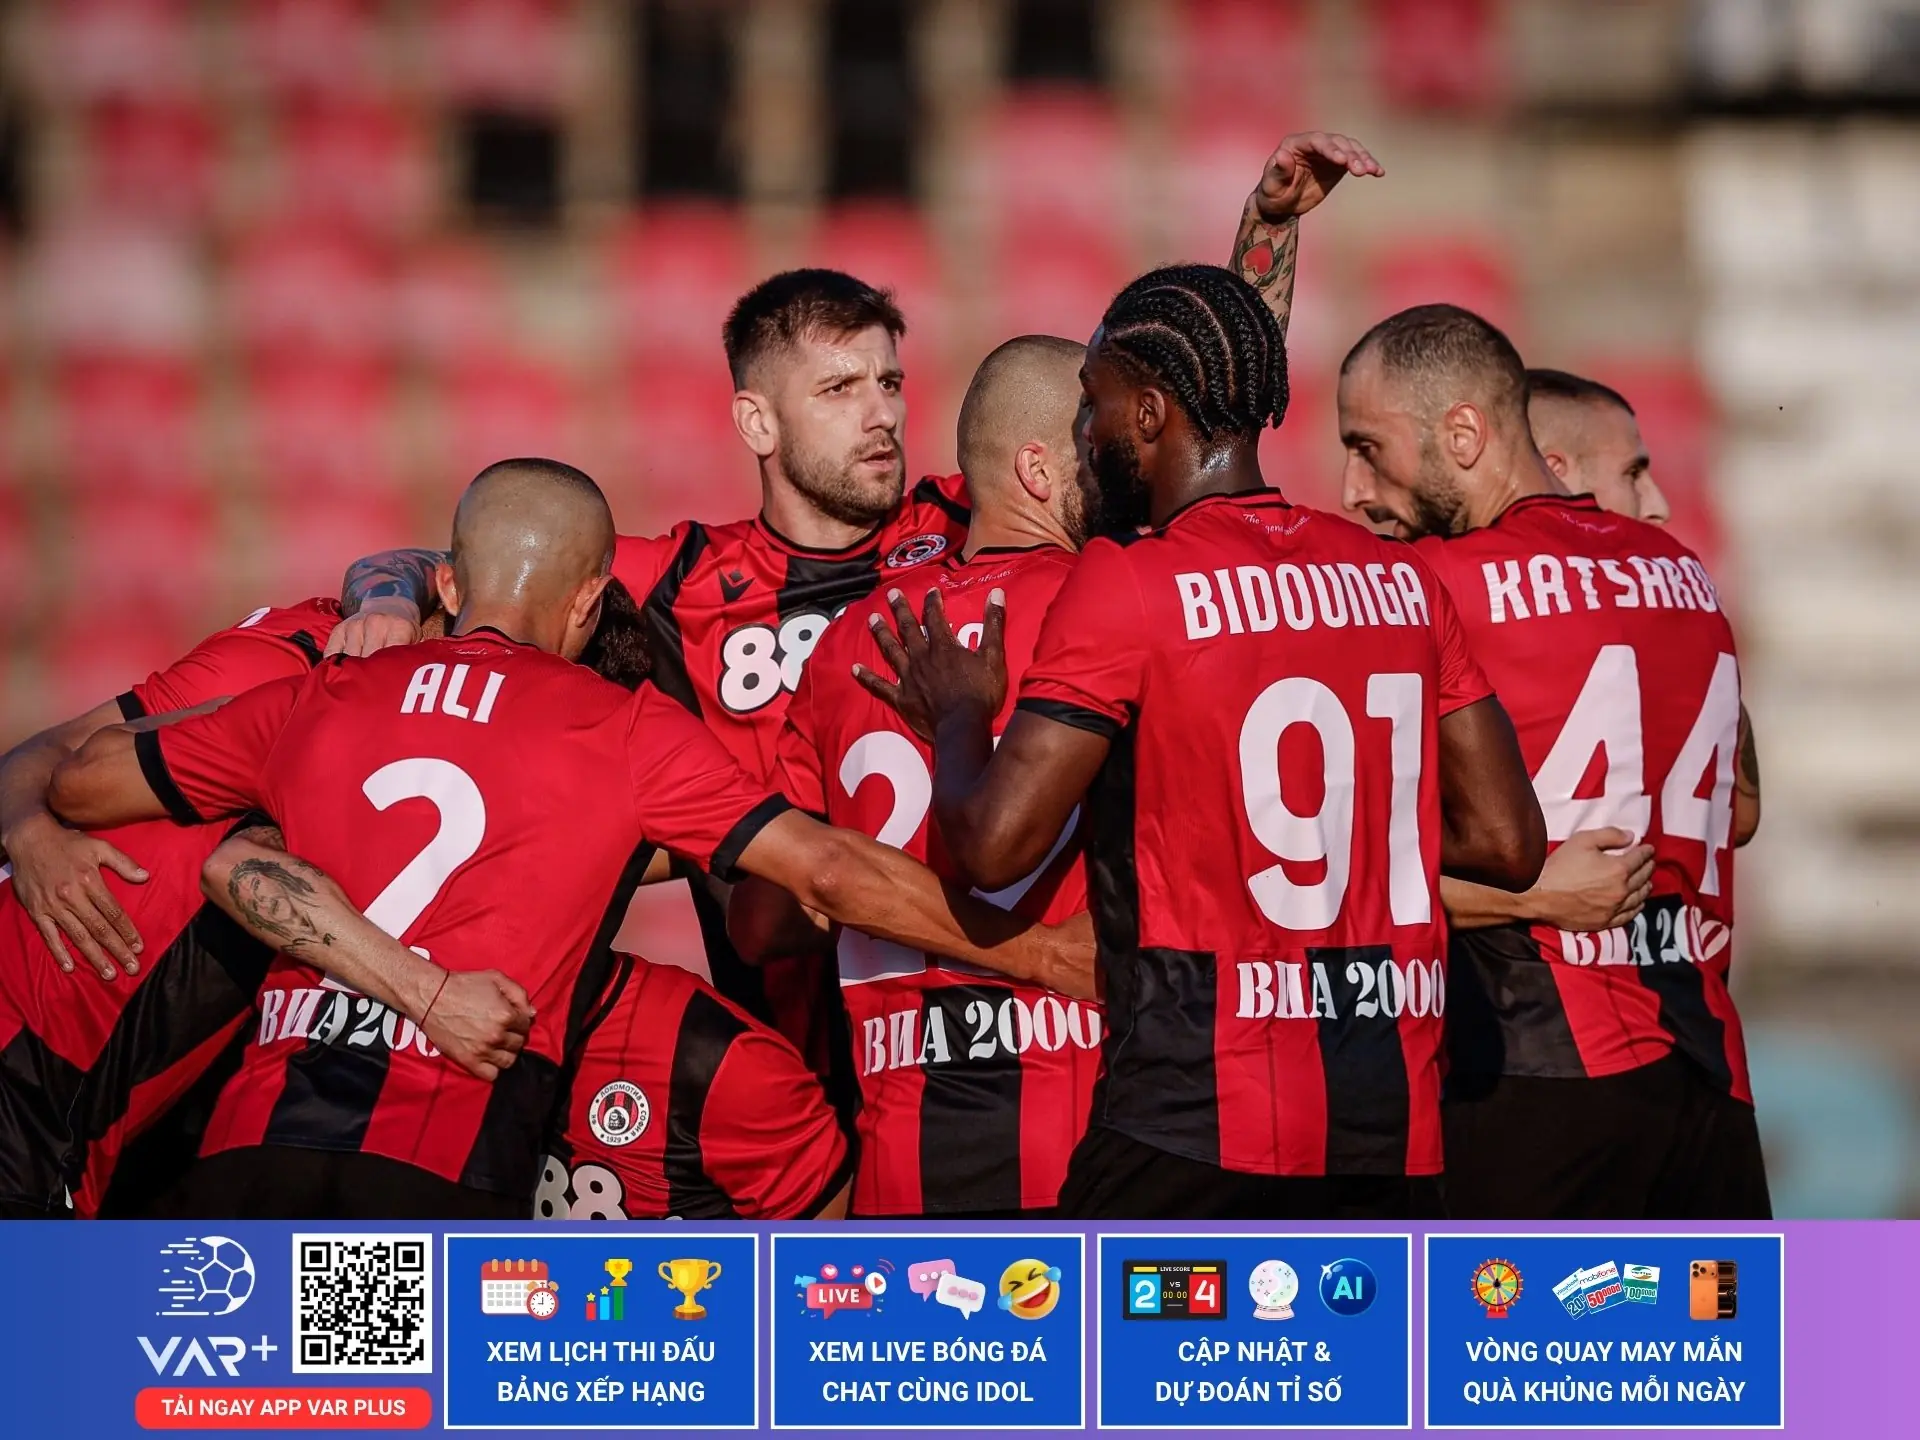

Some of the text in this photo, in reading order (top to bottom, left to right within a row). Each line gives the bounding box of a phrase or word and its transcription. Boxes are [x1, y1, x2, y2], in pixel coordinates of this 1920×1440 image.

[1174, 561, 1431, 641] BIDOUNGA
[399, 662, 507, 724] ALI
[720, 605, 848, 711] 88
[1238, 672, 1433, 931] 91
[1532, 644, 1740, 897] 44
[318, 757, 487, 996] 2
[258, 988, 350, 1047] ВИА
[1345, 958, 1446, 1019] 2000
[863, 997, 1101, 1077] ВИА 2000
[600, 1084, 642, 1101] ЛОКОМОТИВ
[606, 1135, 622, 1144] 1929
[533, 1154, 684, 1220] 88
